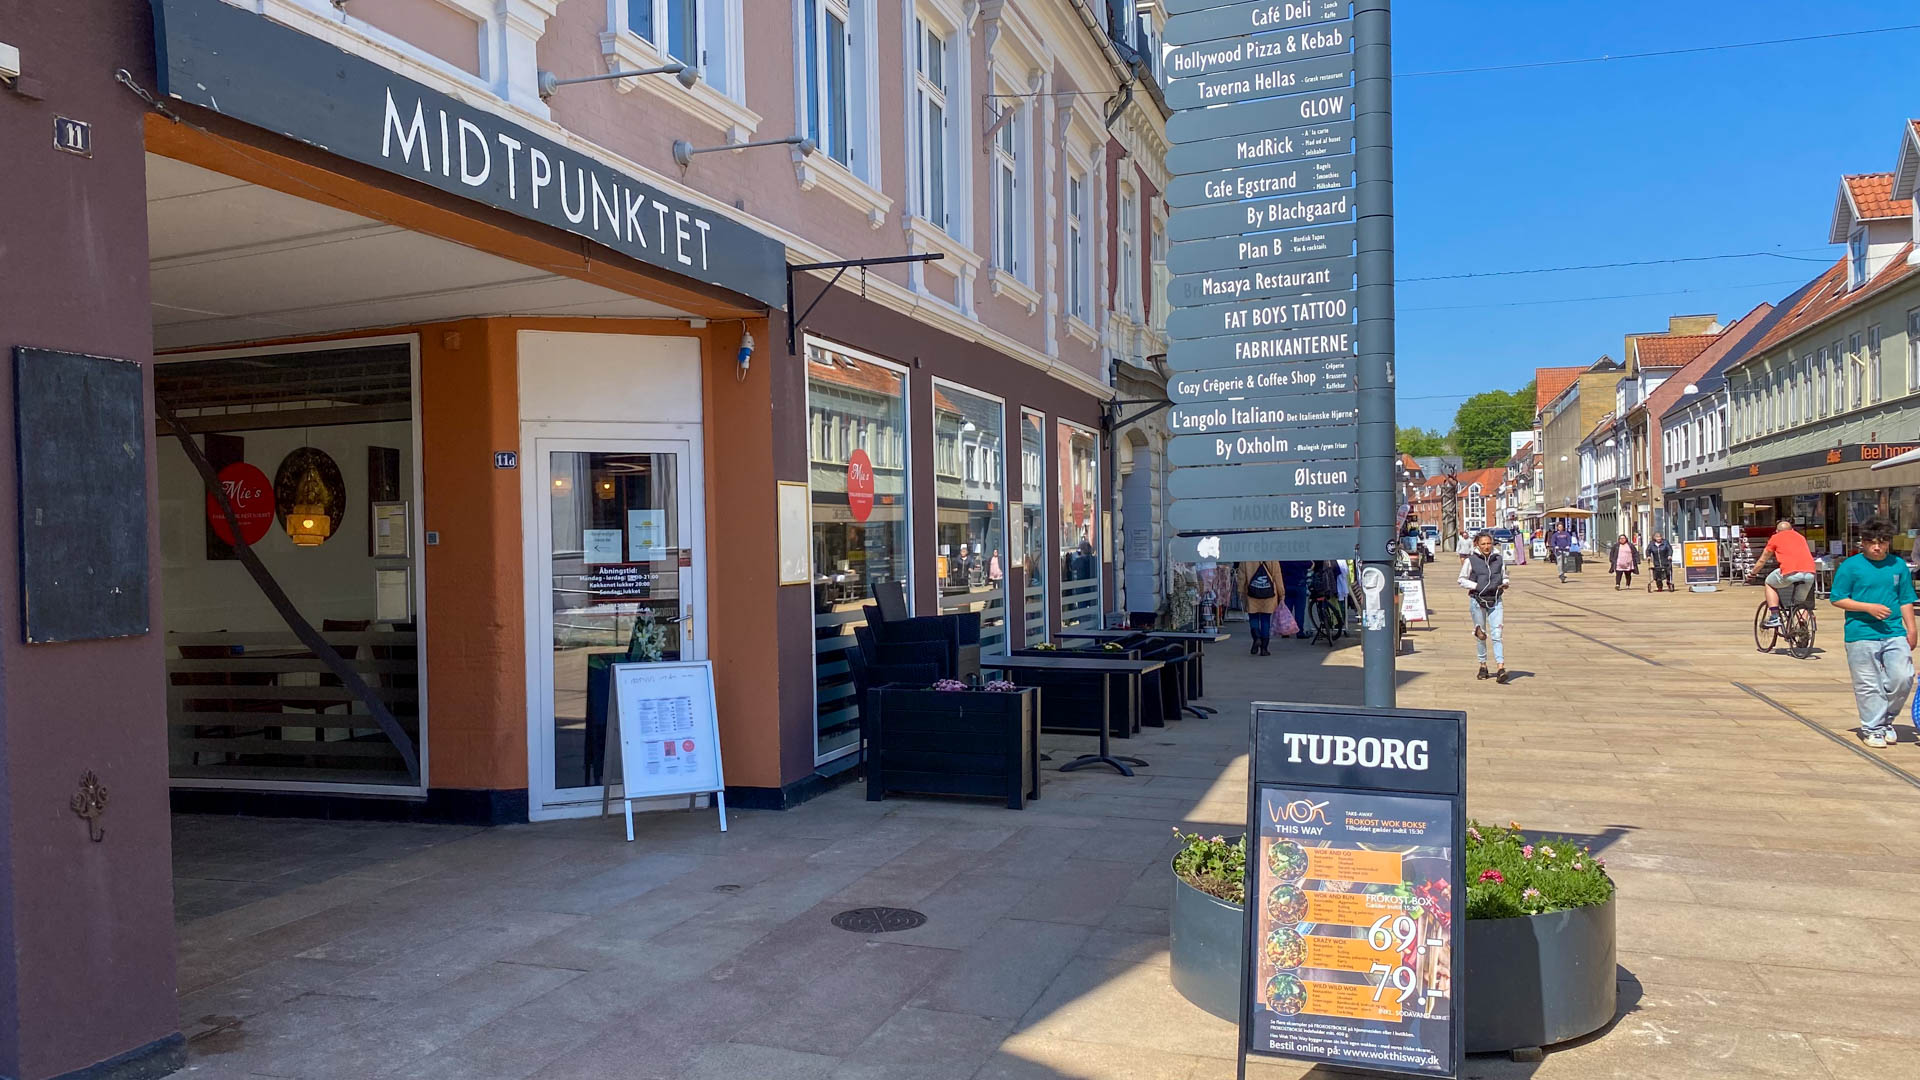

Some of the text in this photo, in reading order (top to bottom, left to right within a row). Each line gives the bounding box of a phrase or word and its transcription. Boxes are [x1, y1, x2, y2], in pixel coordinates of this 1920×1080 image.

[1252, 0, 1311, 26] Café Deli
[1174, 28, 1343, 71] Hollywood Pizza & Kebab
[1198, 70, 1296, 99] Taverna Hellas
[1300, 96, 1343, 119] GLOW
[66, 122, 84, 149] 11
[1237, 136, 1293, 160] MadRick
[382, 86, 711, 270] MIDTPUNKTET
[1205, 171, 1296, 198] Cafe Egstrand
[1247, 196, 1346, 228] By Blachgaard
[1239, 238, 1282, 260] Plan B
[1202, 277, 1250, 297] Masaya
[1255, 268, 1331, 290] Restaurant
[1224, 299, 1347, 330] FAT BOYS TATTOO
[1235, 334, 1348, 360] FABRIKANTERNE
[1178, 370, 1317, 398] Cozy Crêperie & Coffee Shop
[1172, 406, 1353, 432] L'angolo Italiano Det Italienske Hjørne
[498, 454, 515, 466] 11d
[1216, 436, 1288, 460] By Oxholm
[1861, 444, 1882, 460] feel
[1294, 468, 1348, 486] Ølstuen
[1290, 500, 1346, 524] Big Bite
[599, 566, 638, 575] Åbningstid:
[1283, 732, 1429, 770] TUBORG
[1275, 824, 1324, 836] THIS WAY
[1345, 818, 1427, 829] FROKOST WOK BOKSE
[1366, 895, 1433, 906] FROKOST BOX
[1395, 1010, 1430, 1019] SODAVAND
[1270, 1040, 1440, 1066] Bestil online på: www.wokthisway.dk
